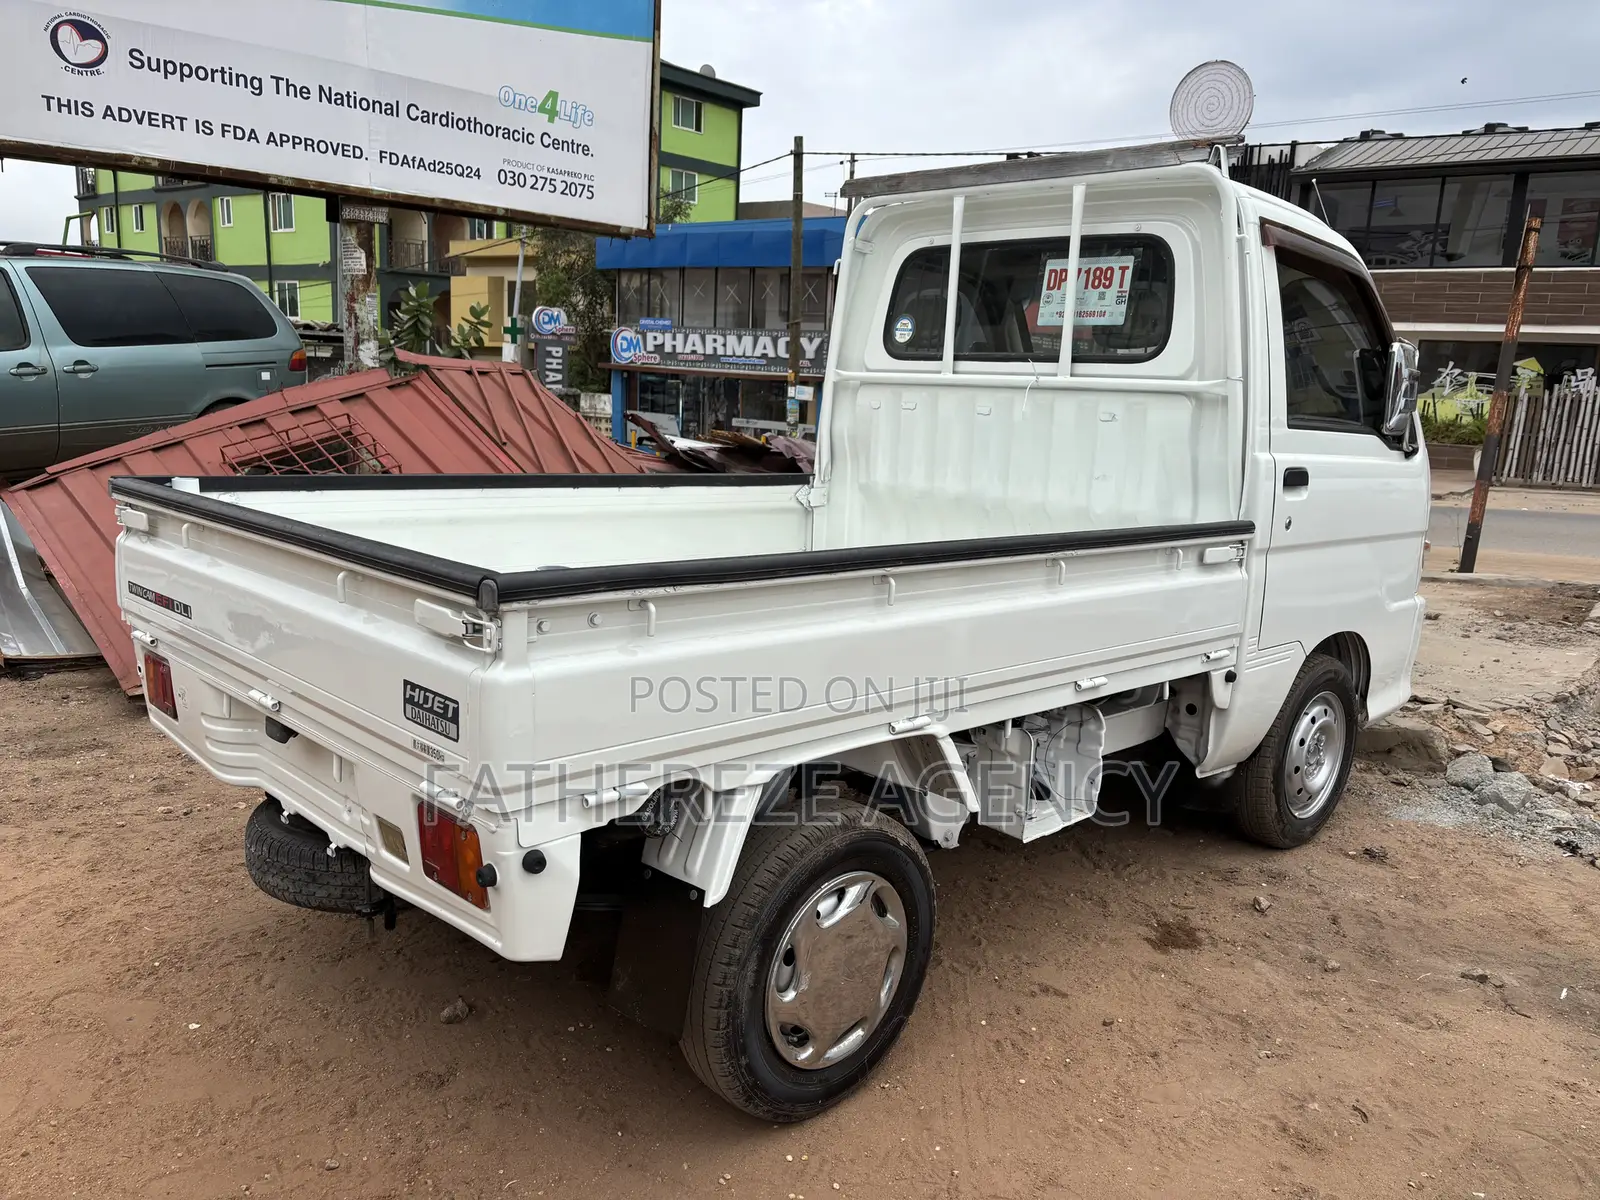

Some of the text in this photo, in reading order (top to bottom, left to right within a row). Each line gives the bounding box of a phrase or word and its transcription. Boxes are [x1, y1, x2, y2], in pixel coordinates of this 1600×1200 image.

[43, 12, 64, 32] NATIONAL
[128, 48, 594, 157] Supporting The National Cardiothoracic Centre.
[41, 94, 482, 180] THIS ADVERT IS FDA APPROVED. FDAfAd25Q24
[502, 158, 595, 181] PRODUCT OF KASAPREKO PLC
[497, 169, 594, 200] 030 275 2075
[1118, 265, 1130, 289] T
[555, 326, 575, 334] Sphere
[620, 335, 642, 353] DM
[646, 332, 822, 360] PHARMACY
[633, 353, 658, 363] Sphere
[156, 592, 173, 610] EFI
[405, 684, 459, 718] HIJET
[410, 706, 451, 736] DAIHATSU
